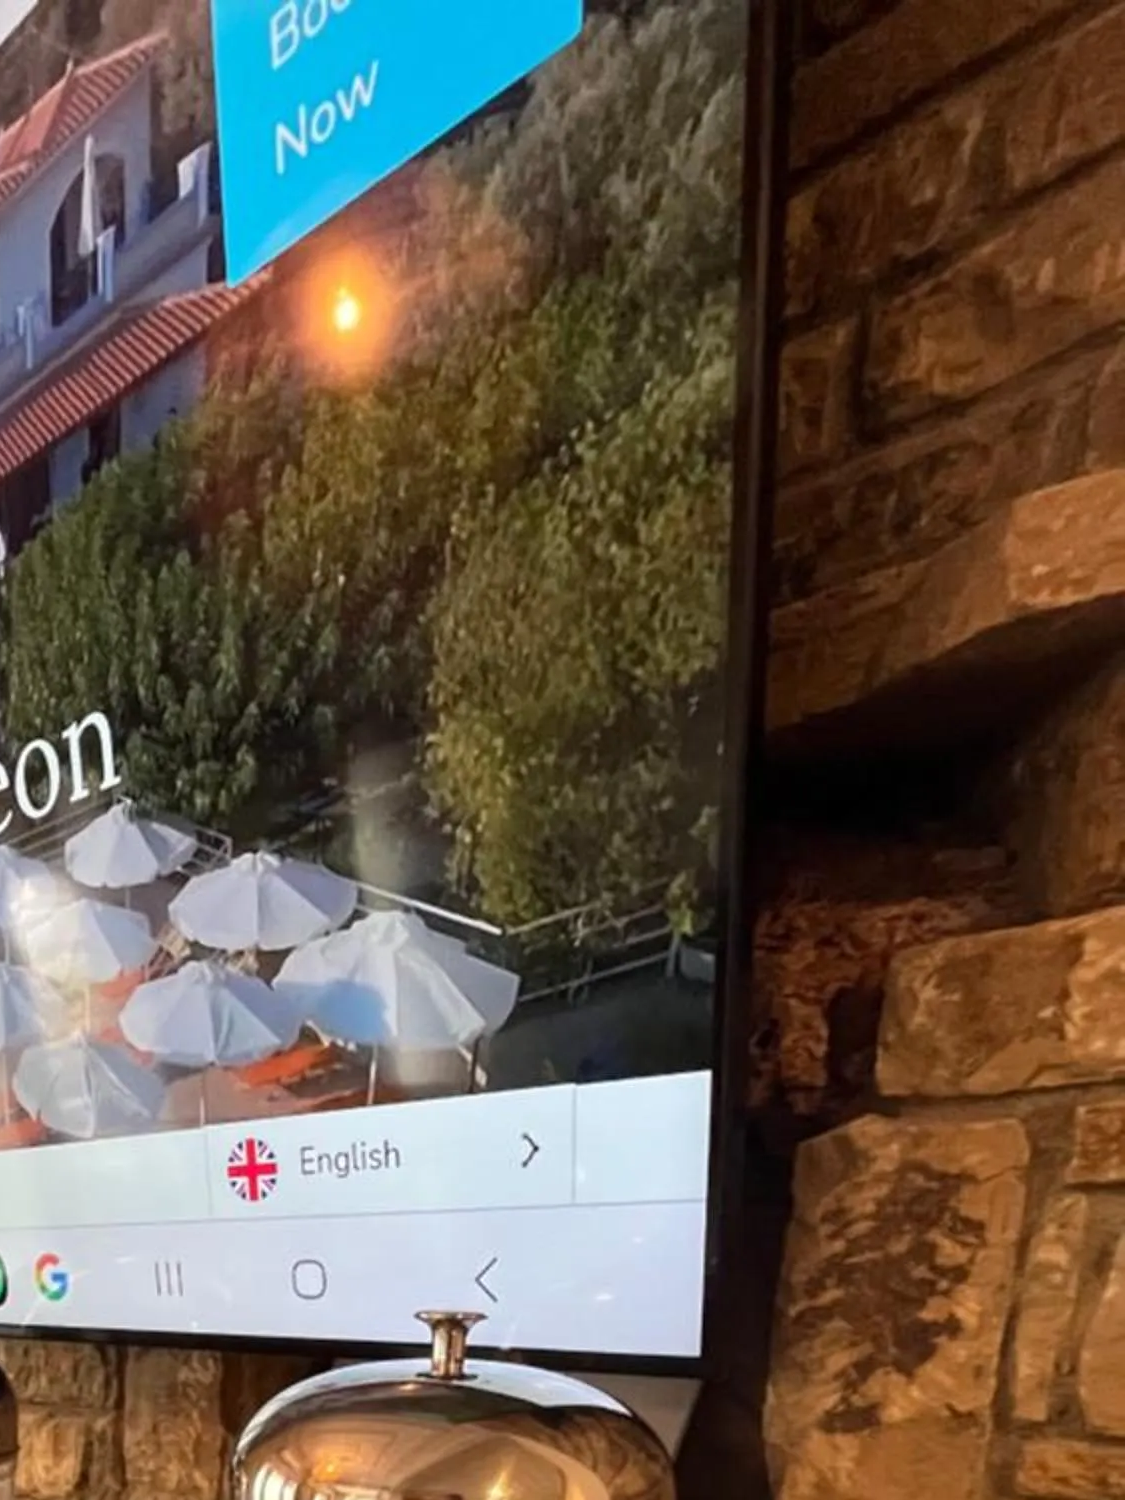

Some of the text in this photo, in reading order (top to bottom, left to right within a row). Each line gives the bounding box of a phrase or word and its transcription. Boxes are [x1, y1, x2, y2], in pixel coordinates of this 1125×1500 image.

[270, 0, 351, 70] Bo
[275, 59, 379, 174] Now
[300, 1139, 401, 1178] English
